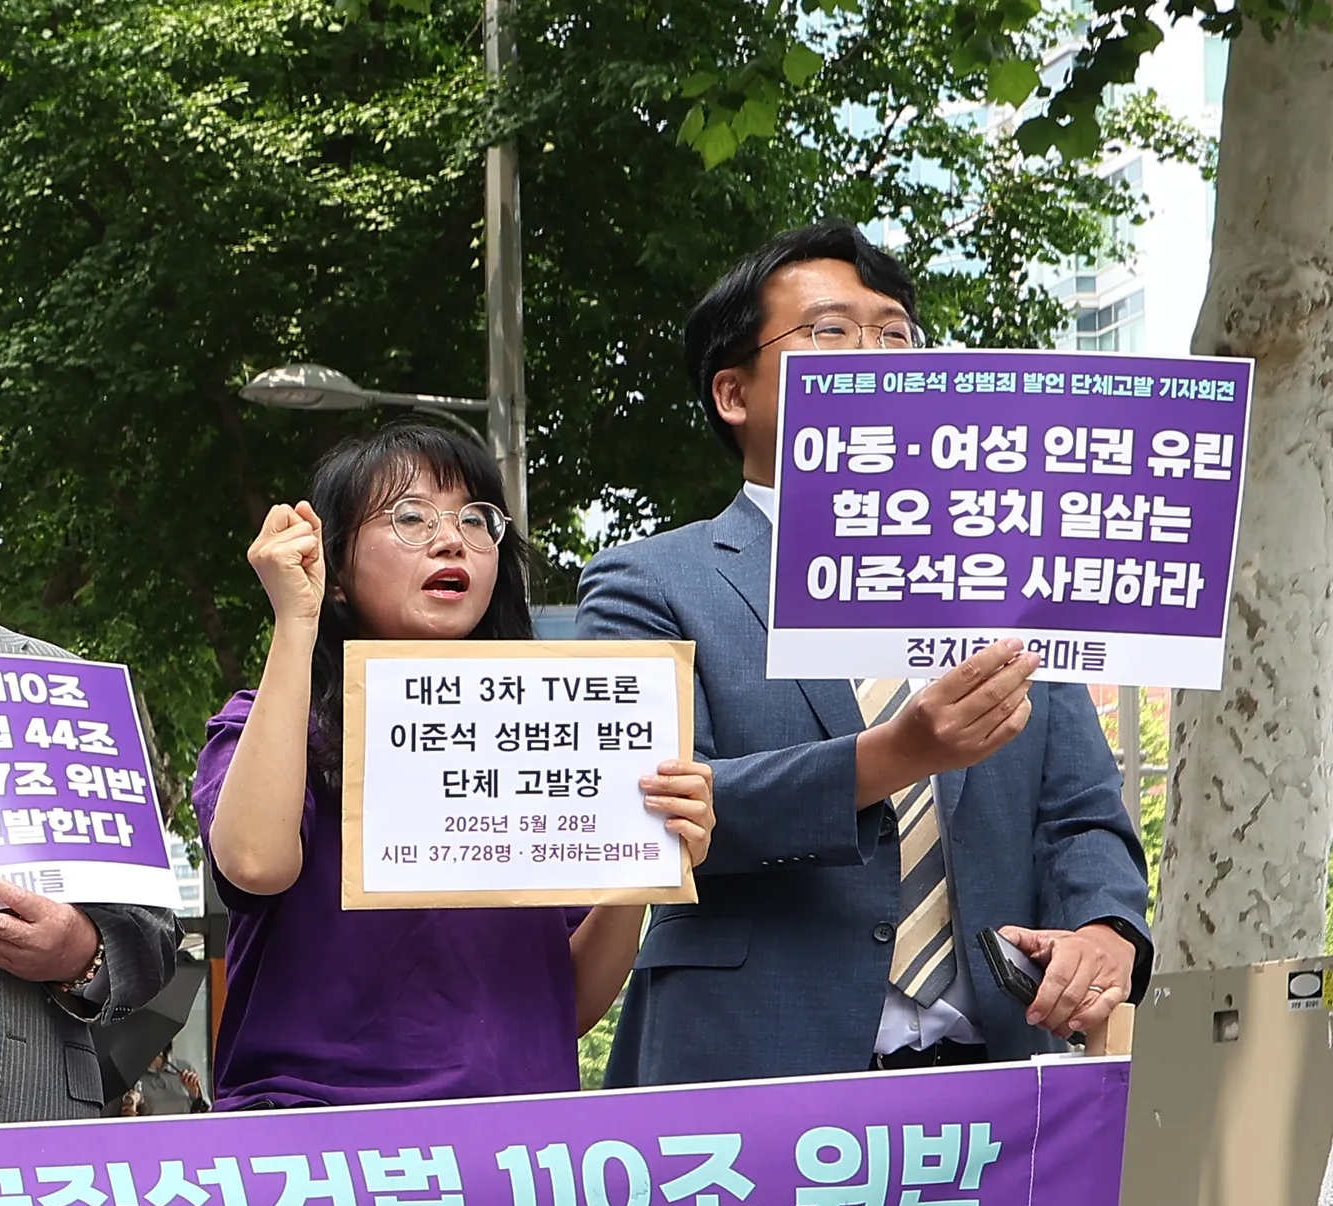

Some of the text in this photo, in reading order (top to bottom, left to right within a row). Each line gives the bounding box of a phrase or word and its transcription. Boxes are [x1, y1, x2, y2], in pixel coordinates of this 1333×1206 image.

[801, 371, 1236, 401] TV토론 이준석 성범죄 발언 단체고발 기자회견
[1044, 426, 1133, 476] 인권
[1147, 430, 1235, 481] 유린
[833, 490, 1192, 543] 혐오 정치 일삼는
[807, 554, 1204, 609] 이준석은 사퇴하라
[906, 637, 1107, 672] 정치엄마들
[405, 675, 641, 706] 대선 3차 TV토론
[25, 717, 119, 756] 44조
[390, 721, 654, 752] 이준석 성범죄 발언
[65, 766, 147, 805] 위반
[442, 768, 603, 799] 단체 고발장
[444, 814, 597, 834] 2025년 5월 28일
[381, 844, 419, 864] 시민
[429, 843, 512, 864] 37,728명
[530, 842, 662, 863] 정치하는엄마들
